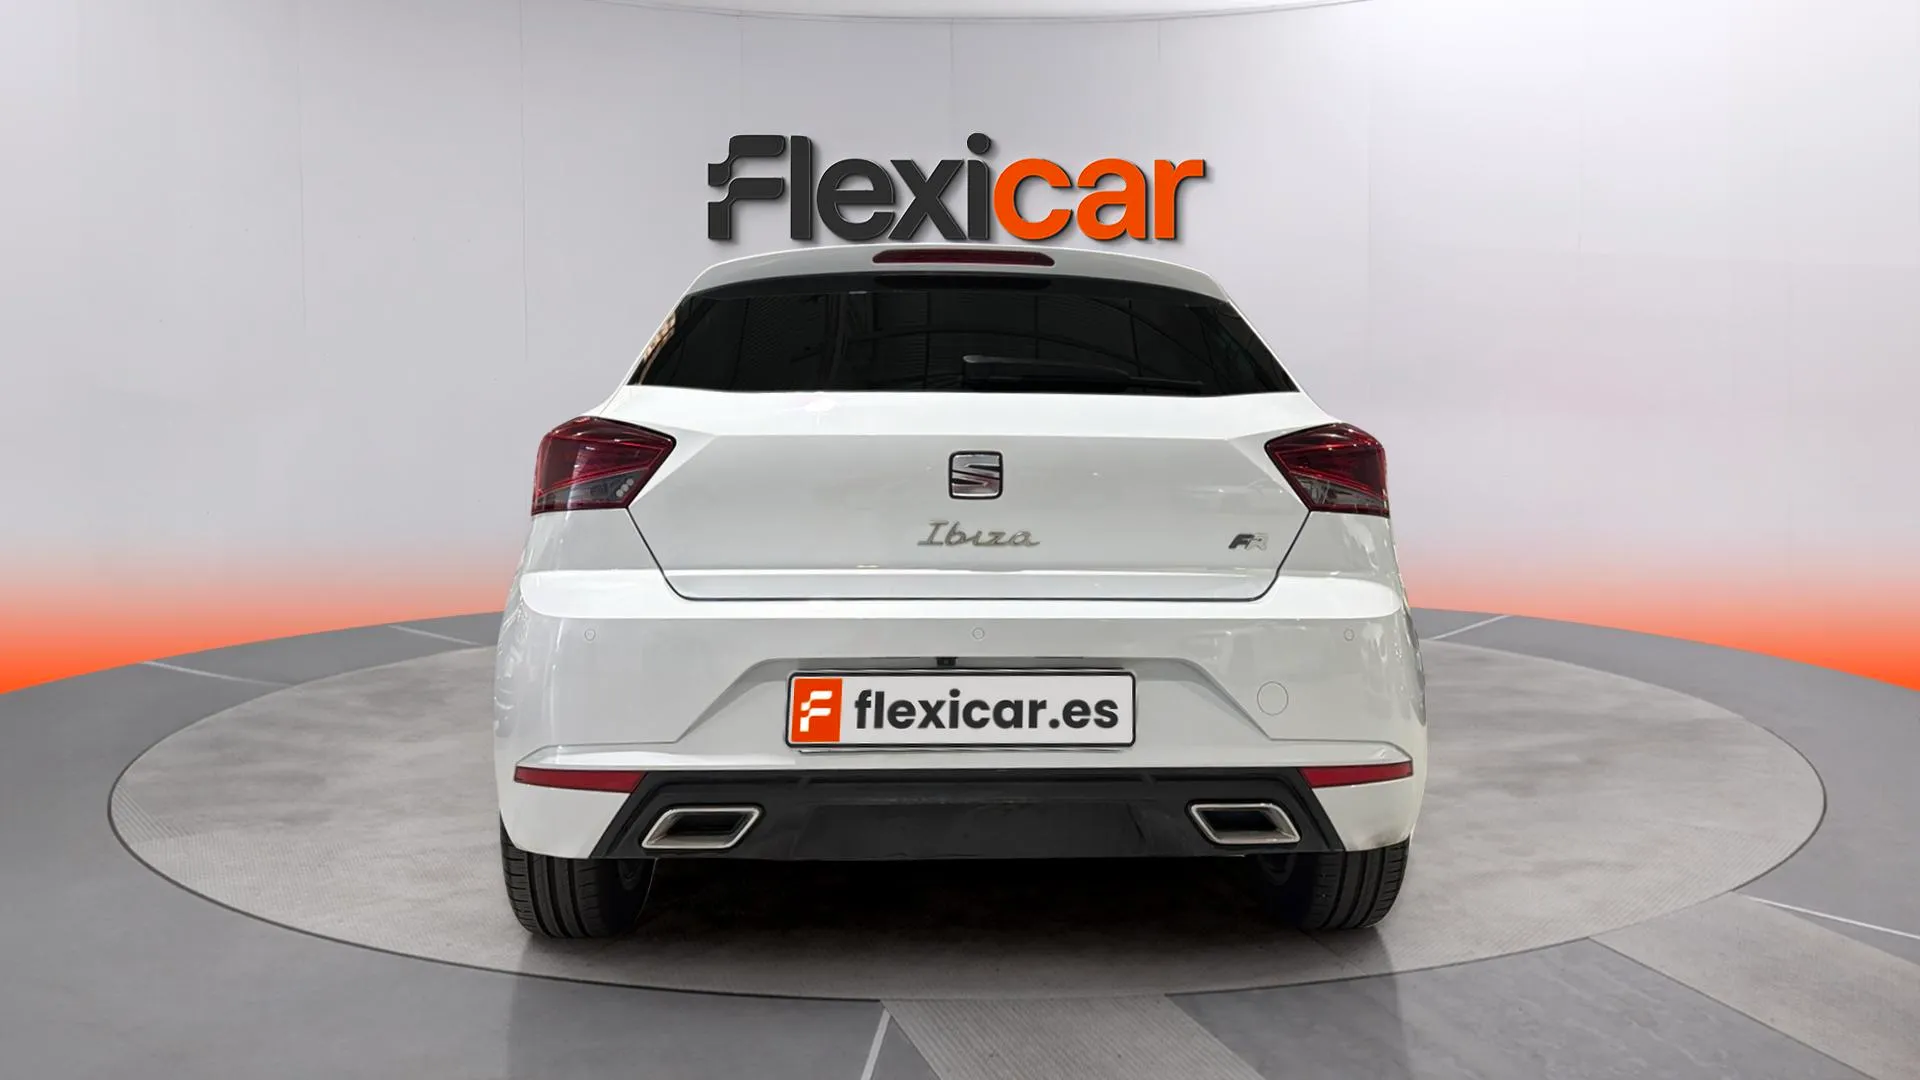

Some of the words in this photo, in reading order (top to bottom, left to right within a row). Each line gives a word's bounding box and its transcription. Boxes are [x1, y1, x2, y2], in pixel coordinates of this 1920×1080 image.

[707, 132, 1205, 241] Flexicar
[916, 520, 1041, 548] Ibiza
[1228, 533, 1270, 550] FR
[854, 688, 1119, 730] flexicar.es
